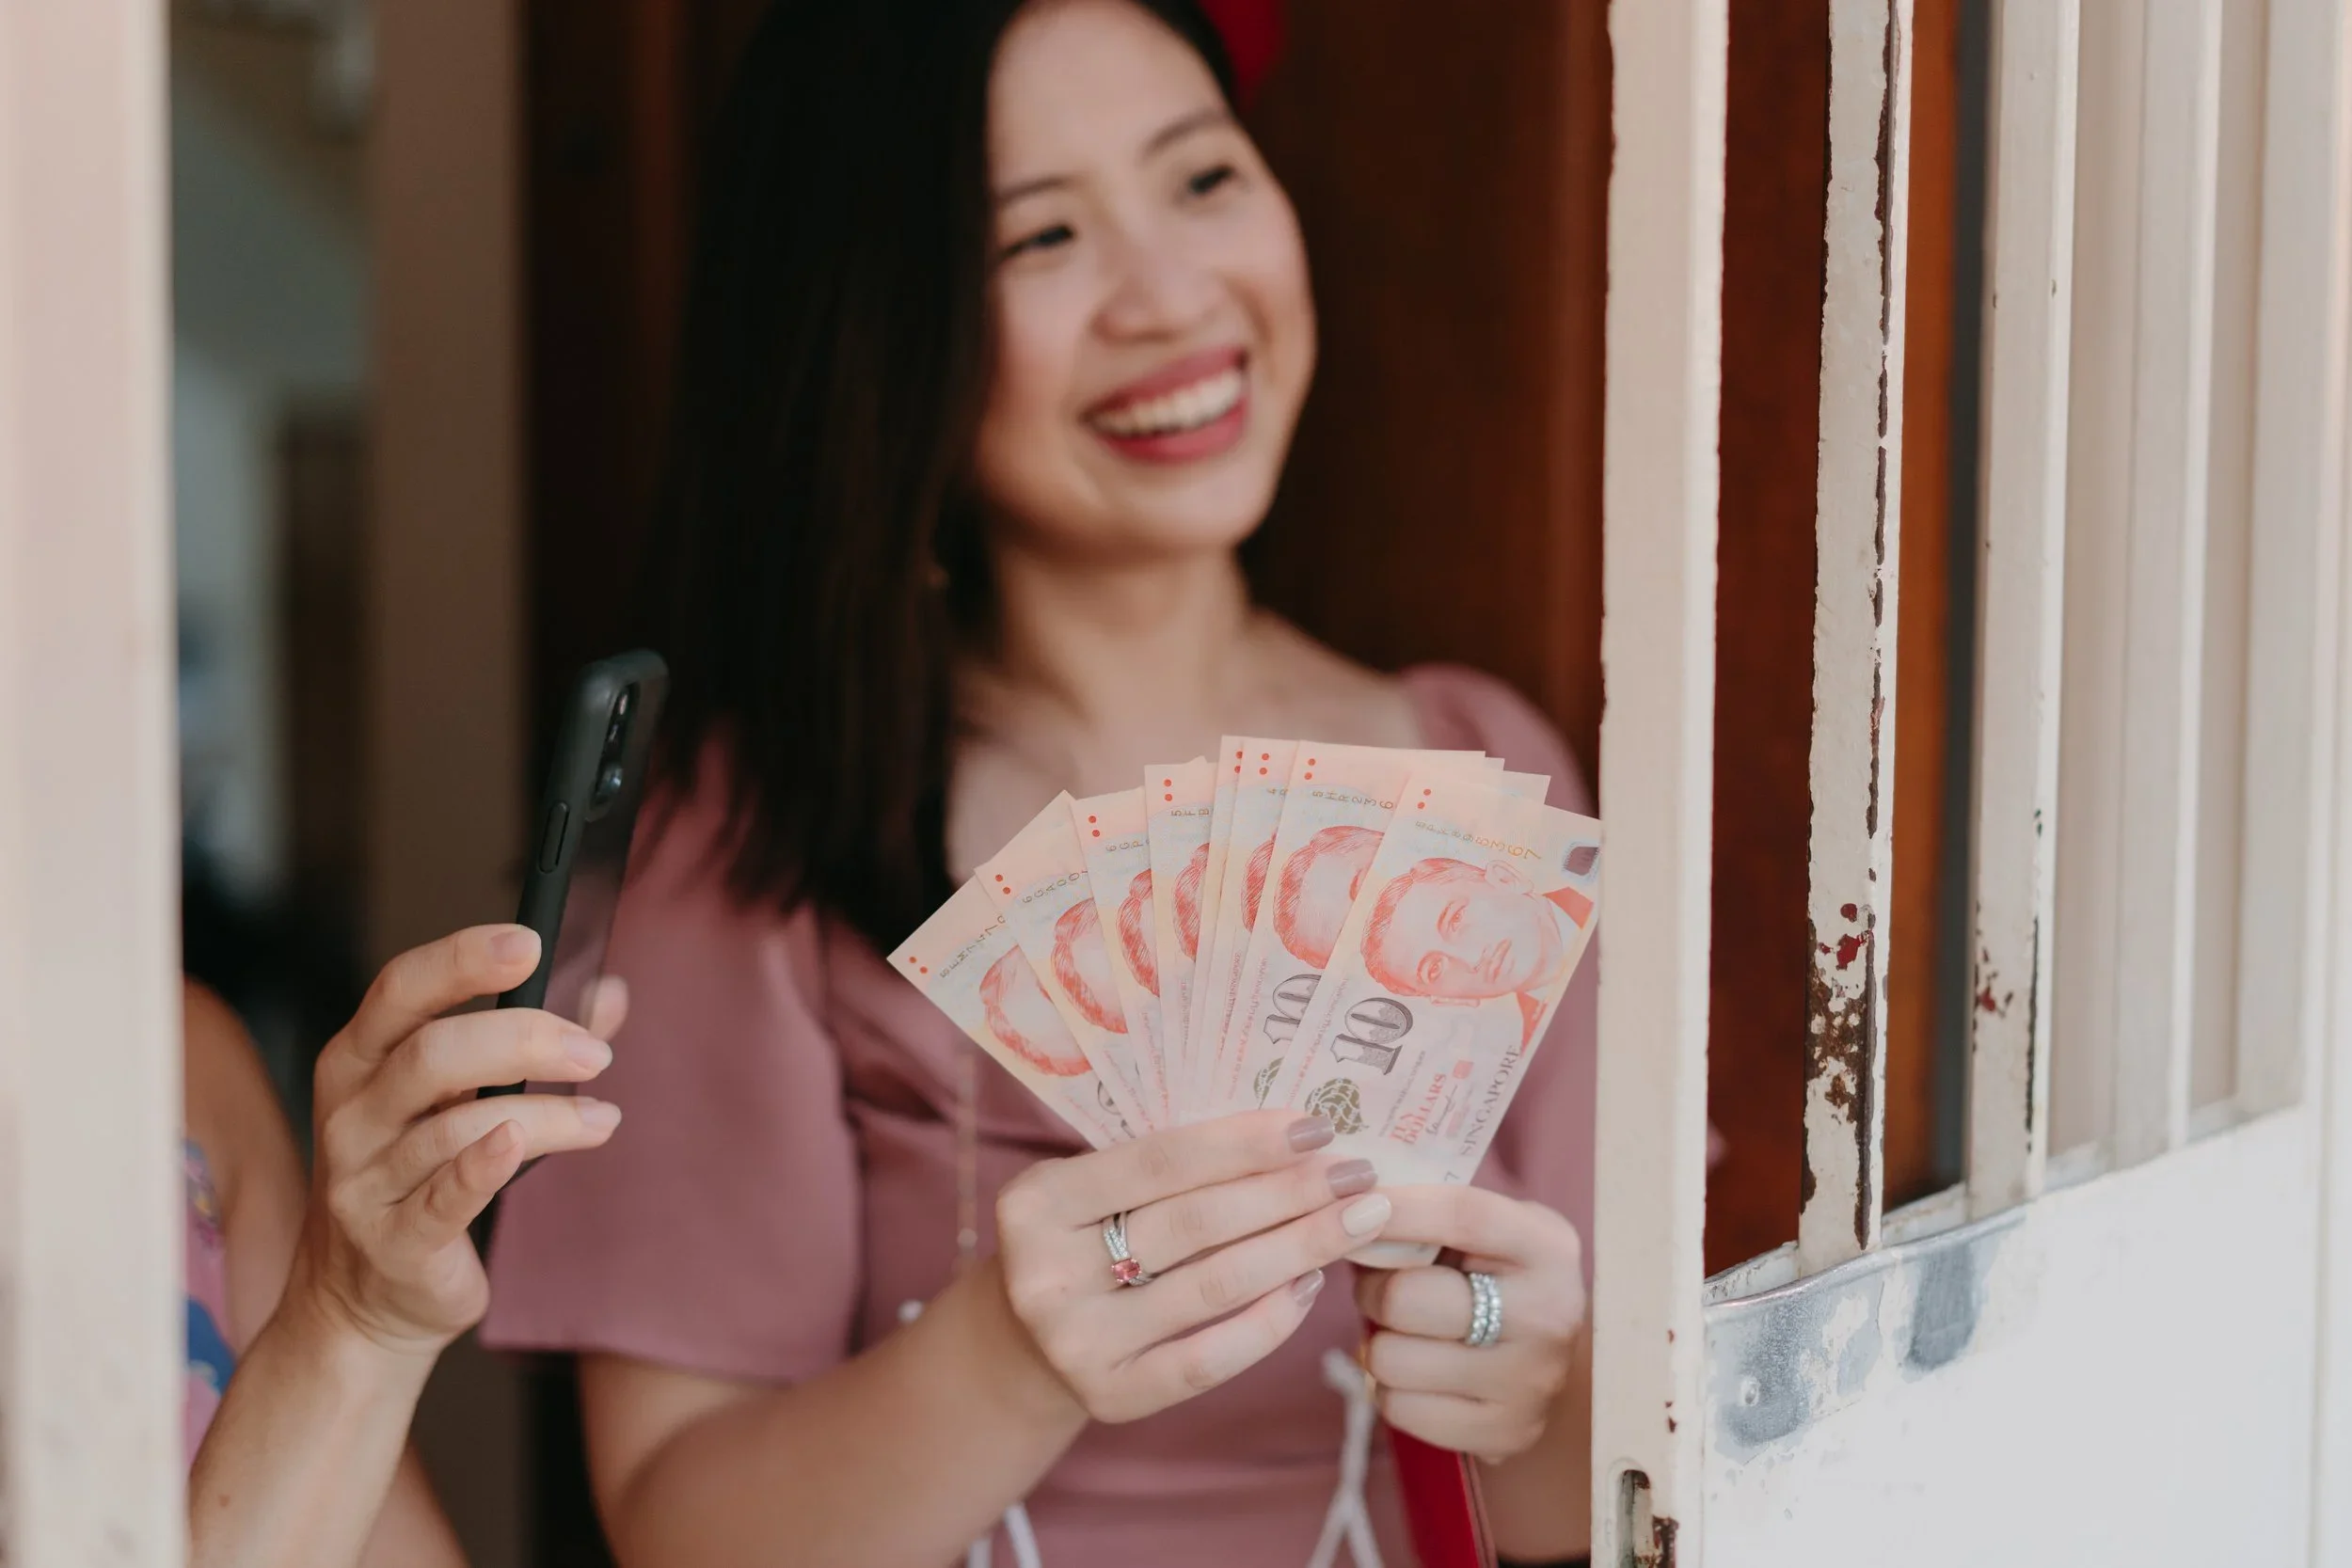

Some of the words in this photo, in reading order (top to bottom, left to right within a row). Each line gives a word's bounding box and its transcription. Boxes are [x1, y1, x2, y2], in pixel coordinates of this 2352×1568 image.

[1329, 997, 1414, 1075] 10
[1390, 1112, 1416, 1142] TEN
[1403, 1072, 1447, 1146] DOLLARS
[1460, 1043, 1522, 1156] SINGAPORE
